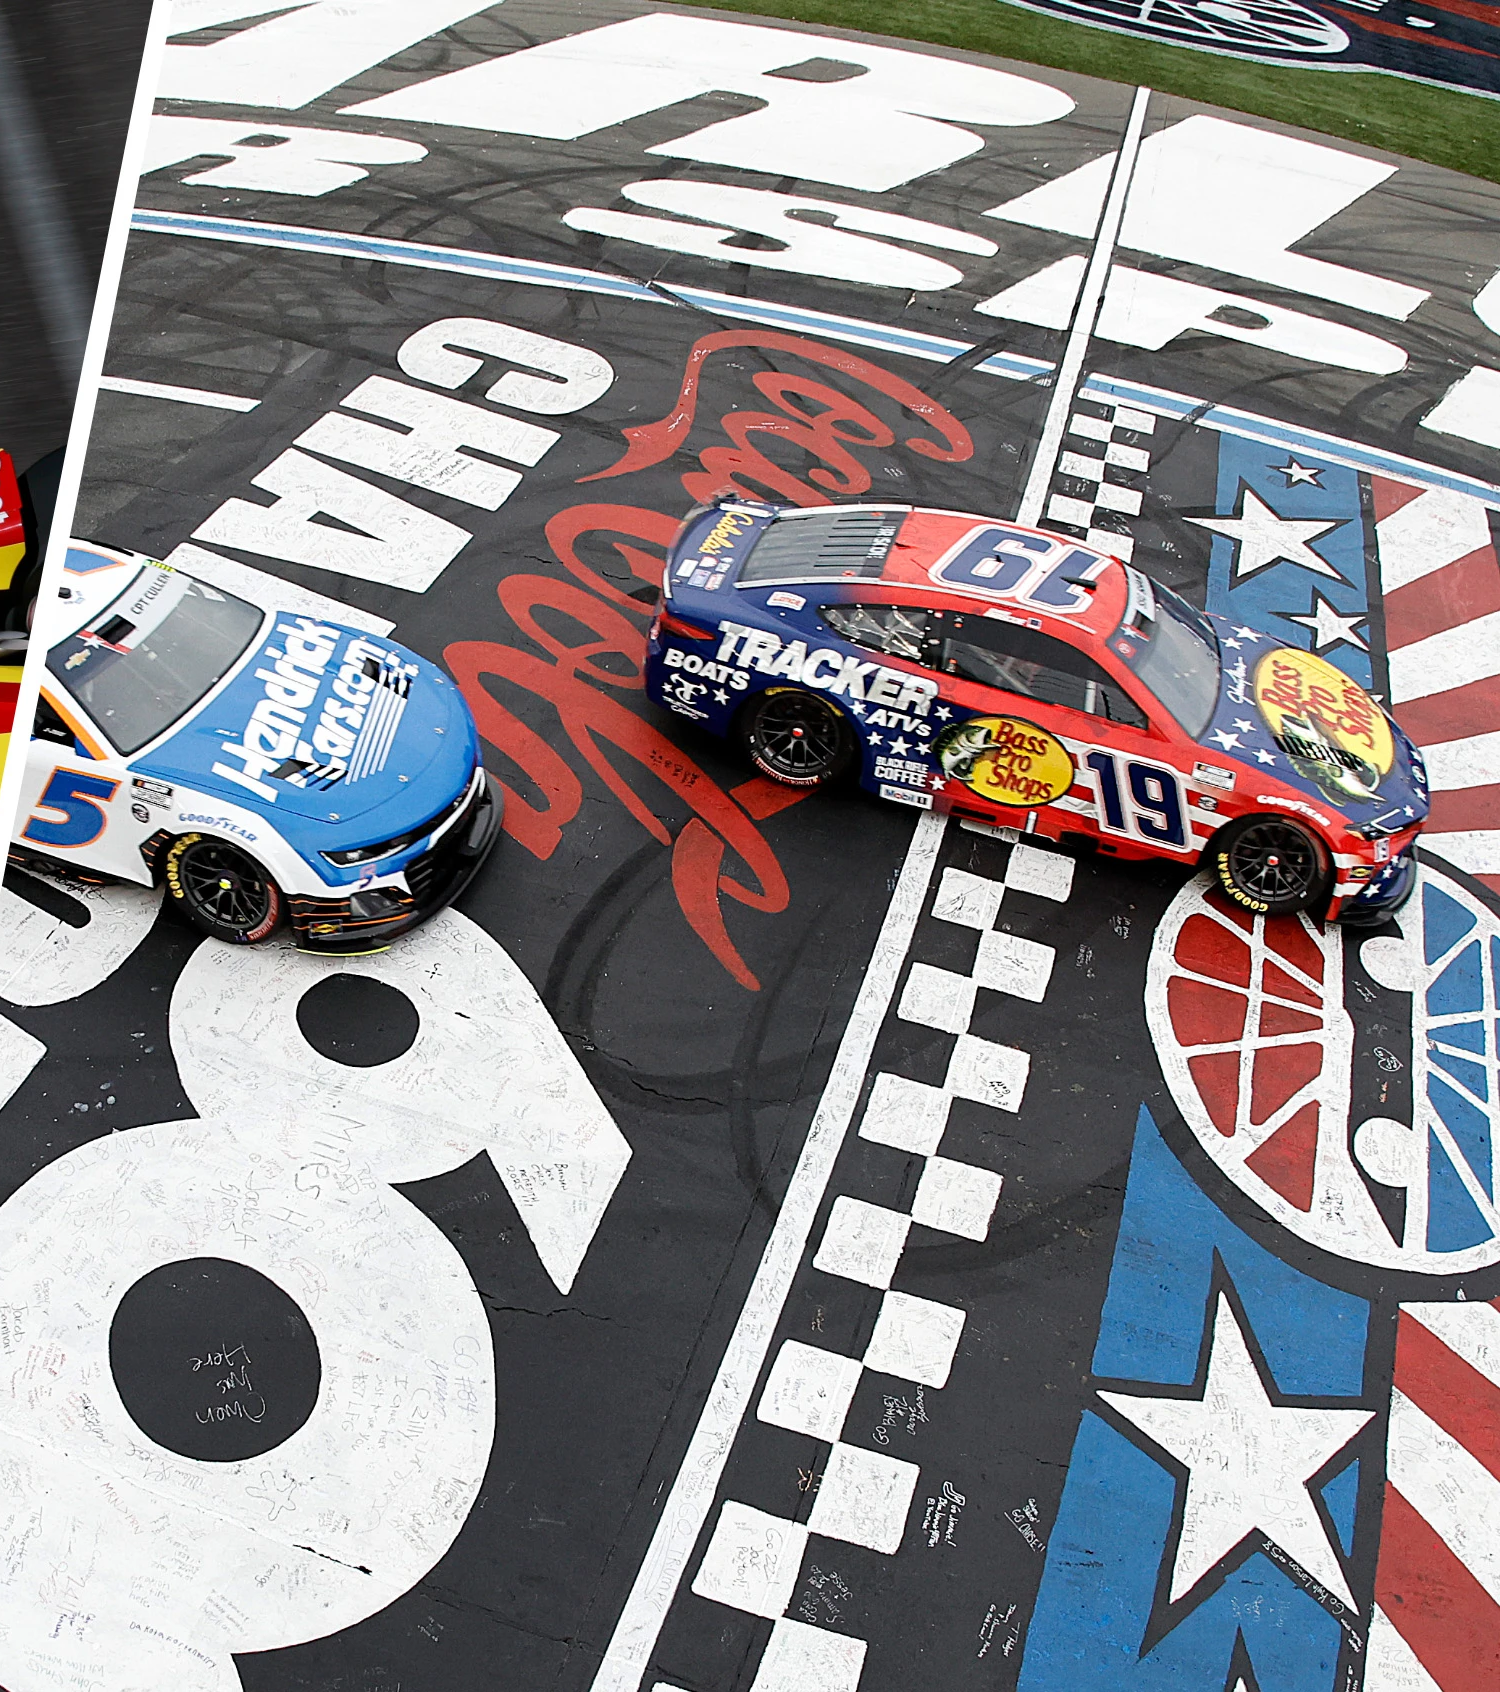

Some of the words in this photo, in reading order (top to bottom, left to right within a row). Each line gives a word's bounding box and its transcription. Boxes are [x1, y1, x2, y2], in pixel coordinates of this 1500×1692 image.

[698, 512, 753, 555] Cabela's
[130, 599, 150, 615] CPT
[145, 573, 171, 601] CULLEN
[663, 648, 750, 691] BOATS
[716, 620, 940, 717] TRACKER
[1262, 659, 1305, 712] Bass
[211, 617, 342, 803] Hendrick
[311, 638, 390, 771] Cars.com
[865, 708, 932, 737] ATVs
[1303, 685, 1342, 732] Pro
[1340, 684, 1382, 749] Shops
[992, 745, 1032, 773] Pro
[993, 721, 1050, 755] Bass
[874, 766, 927, 788] COFFEE
[875, 756, 905, 770] BLACK
[905, 760, 929, 773] RIFLE
[986, 765, 1054, 801] Shops
[20, 765, 123, 849] 5
[885, 788, 915, 802] Mobil
[1086, 750, 1185, 848] 19
[178, 812, 259, 843] GOODYEAR
